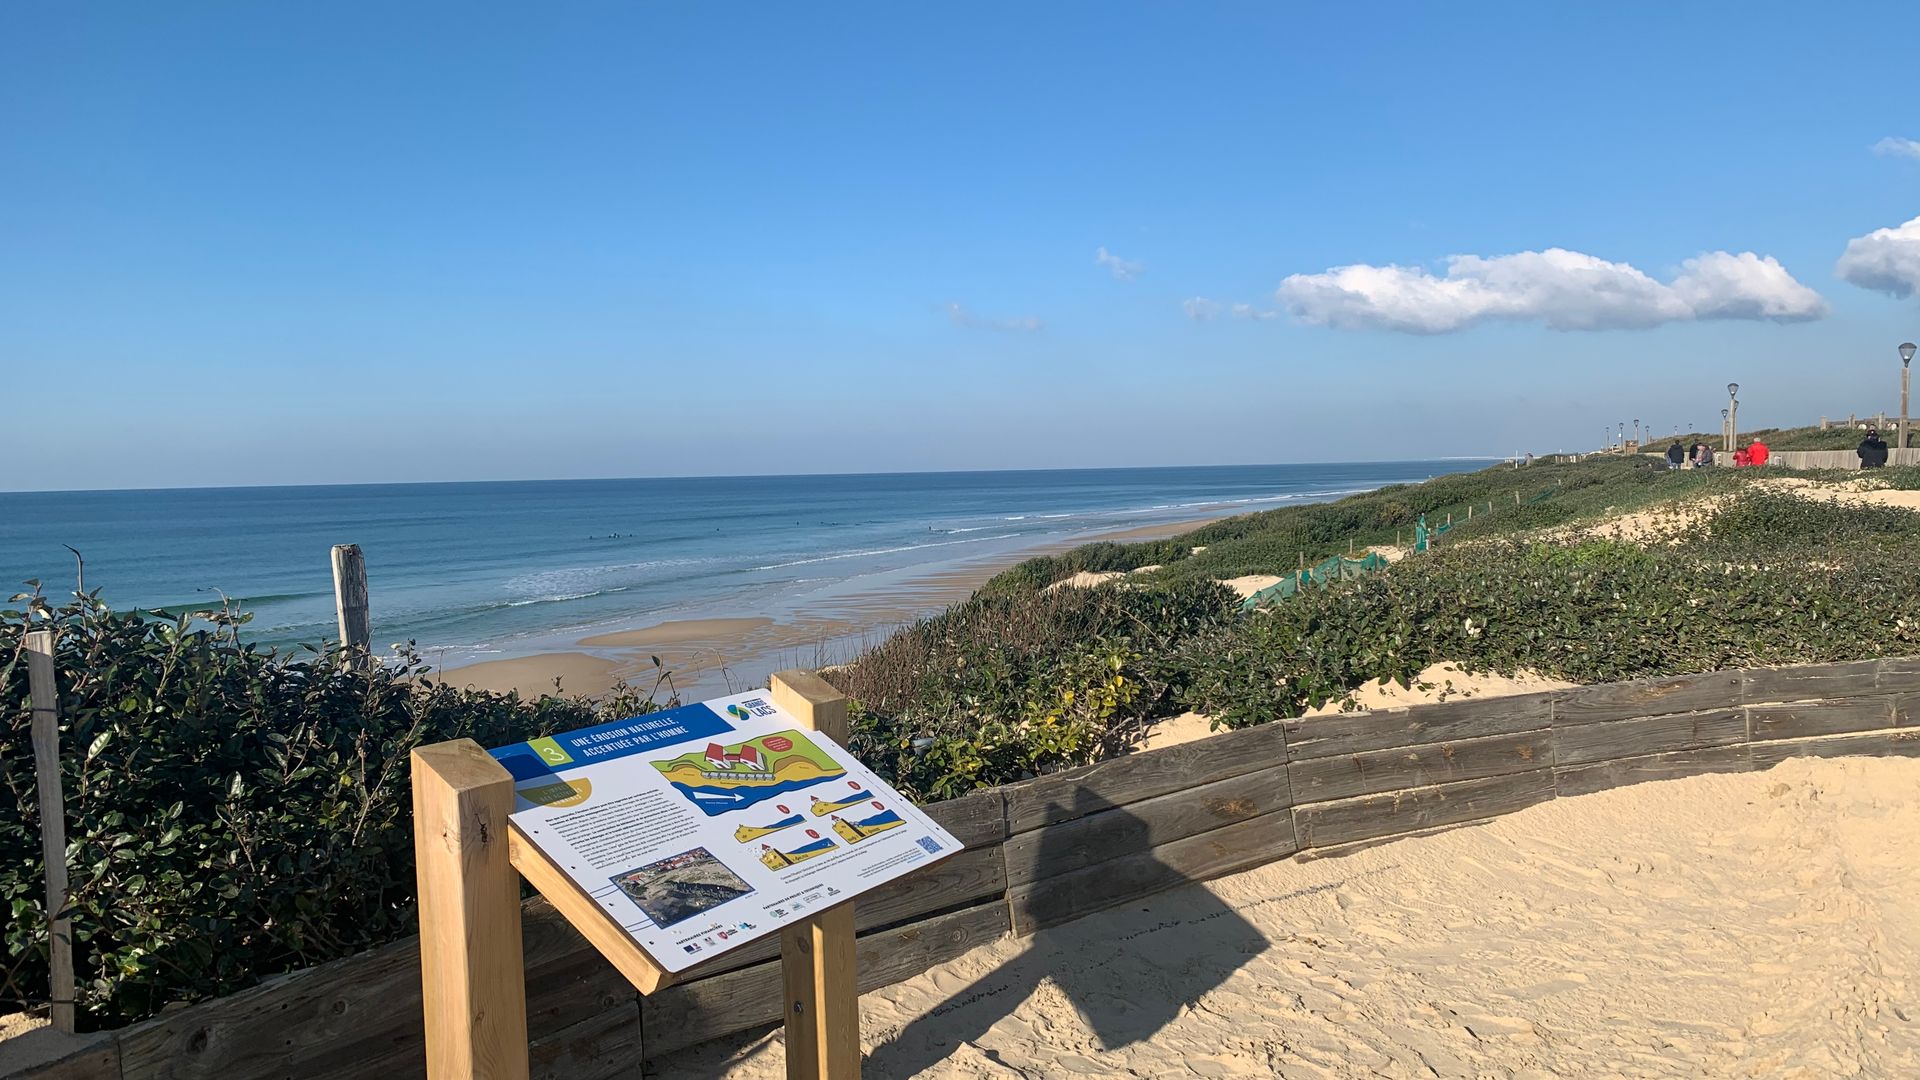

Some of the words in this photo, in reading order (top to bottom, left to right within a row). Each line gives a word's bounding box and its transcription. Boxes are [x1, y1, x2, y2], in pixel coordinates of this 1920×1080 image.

[750, 705, 777, 717] LACS
[571, 736, 592, 747] UNE
[590, 729, 630, 743] ÉROSION
[582, 739, 635, 757] ACCENTUÉE
[632, 734, 652, 745] PAR
[651, 726, 689, 740] L'HOMME
[543, 747, 565, 761] 3
